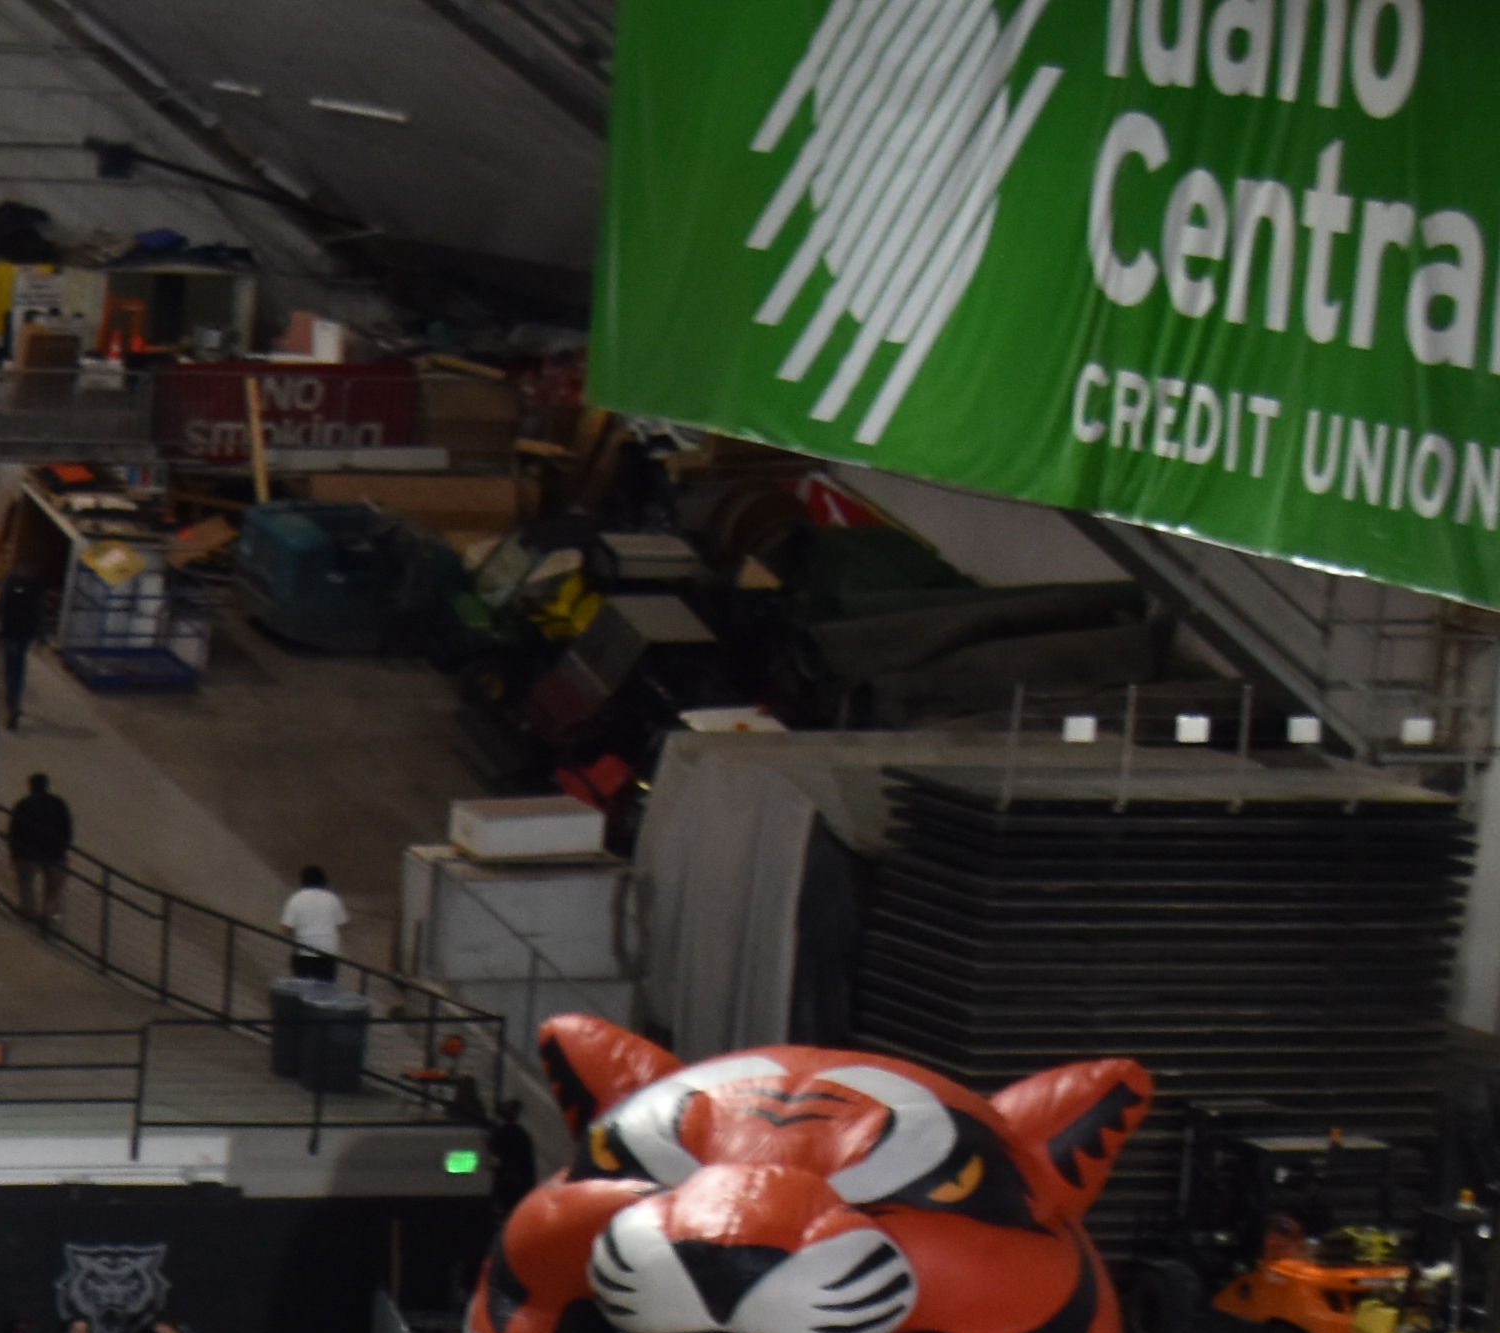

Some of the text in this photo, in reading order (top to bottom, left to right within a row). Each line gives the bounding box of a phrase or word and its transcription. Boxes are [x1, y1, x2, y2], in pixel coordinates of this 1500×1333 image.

[260, 374, 325, 411] NO
[1073, 363, 1500, 531] CREDIT UNION
